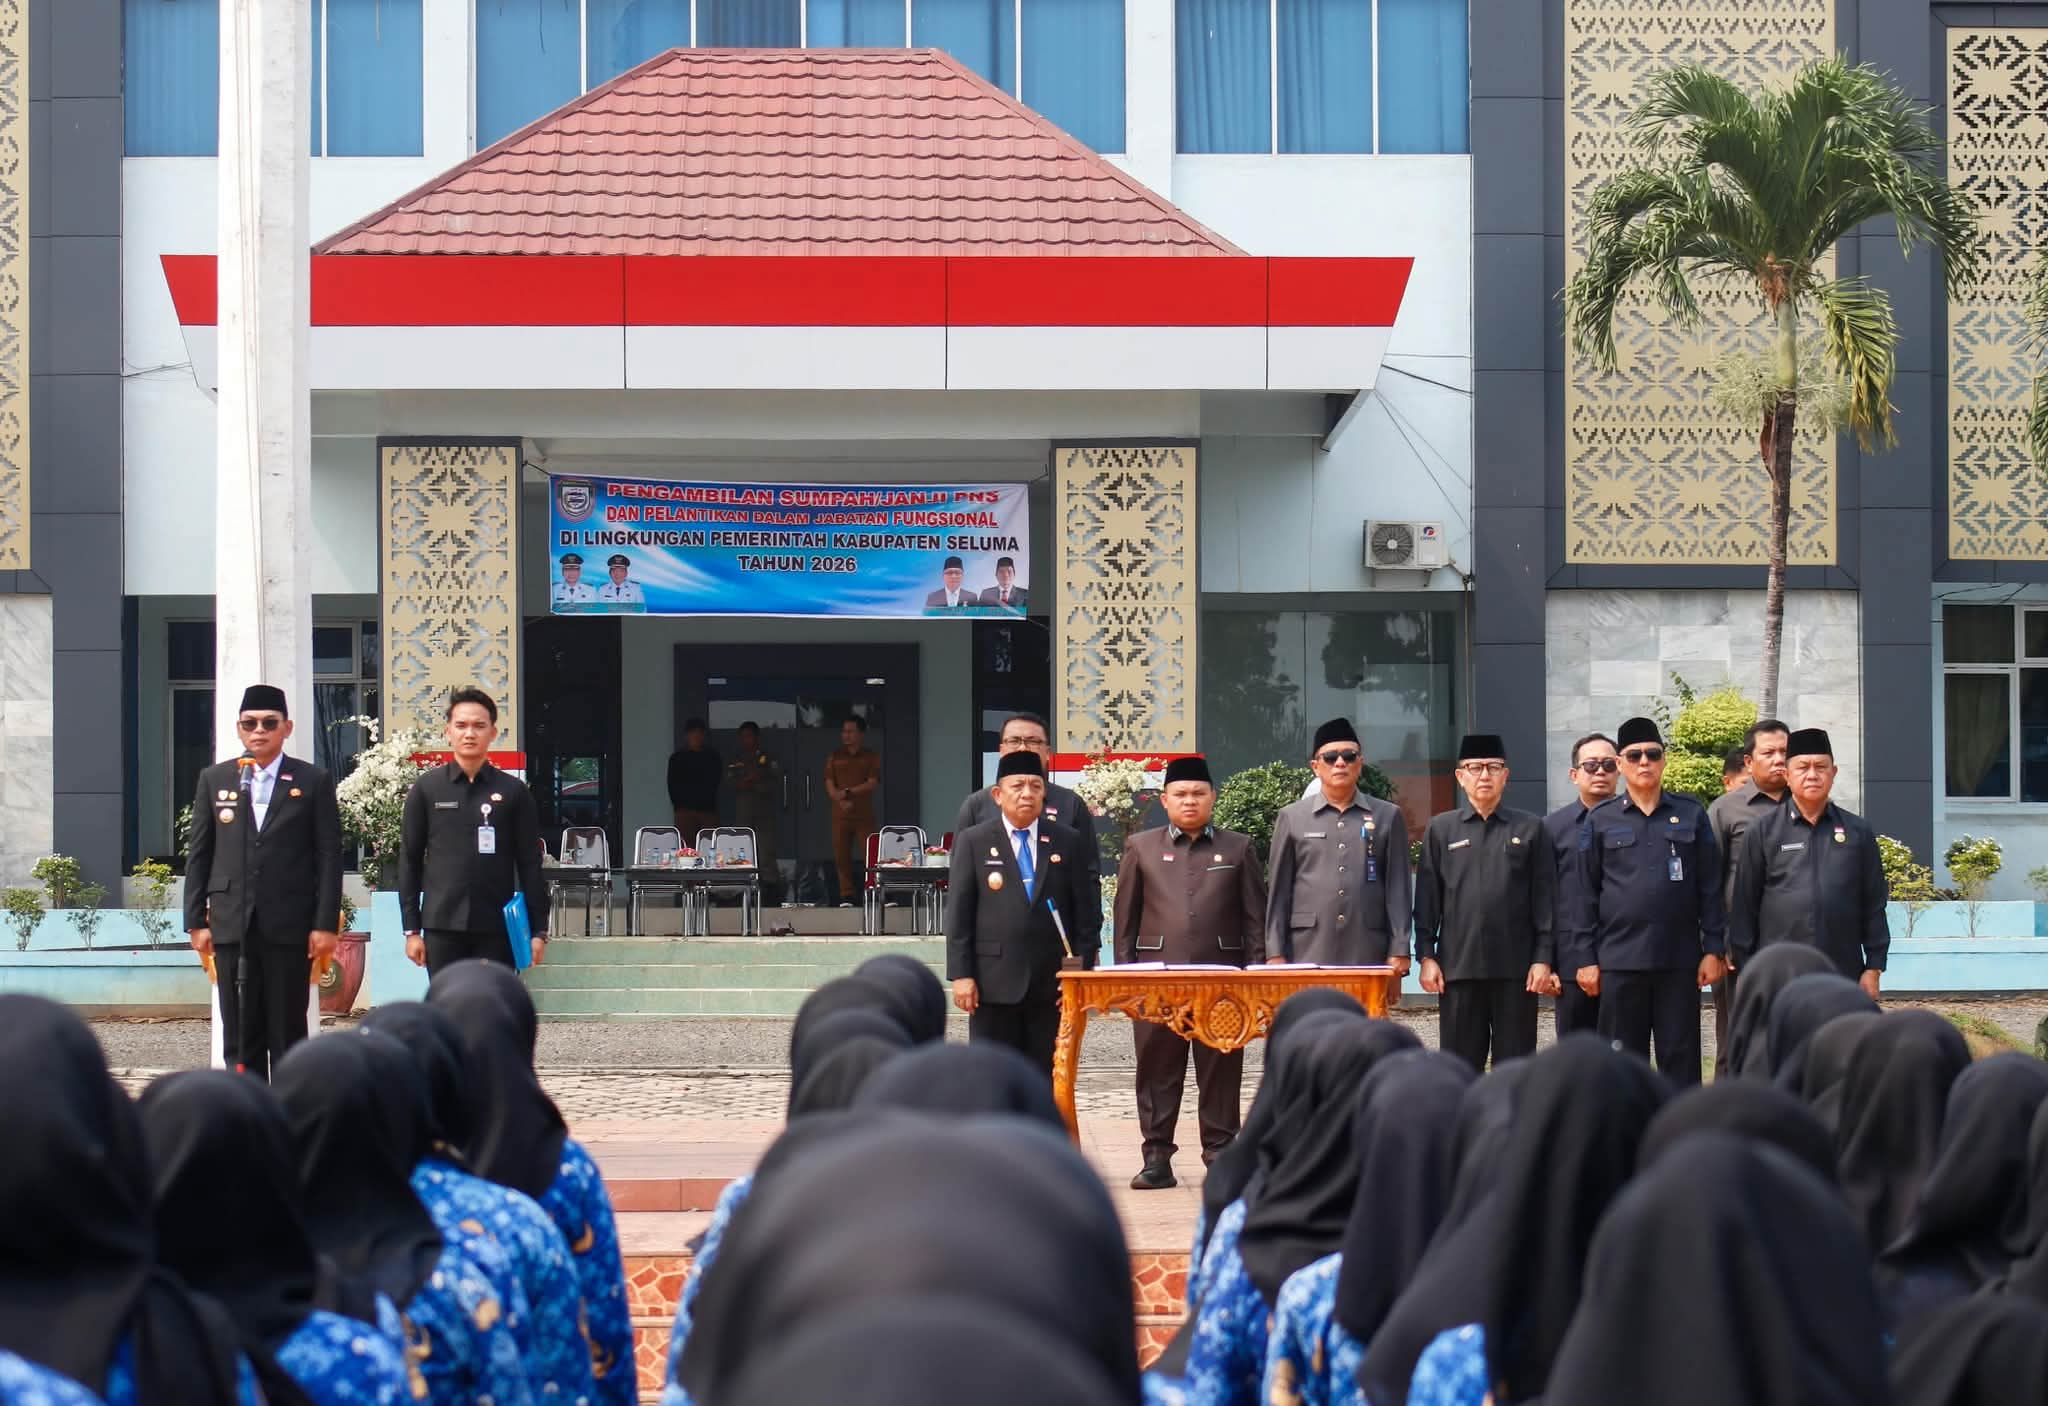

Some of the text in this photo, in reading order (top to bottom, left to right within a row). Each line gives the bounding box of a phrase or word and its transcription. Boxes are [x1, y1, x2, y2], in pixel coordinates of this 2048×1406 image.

[607, 483, 774, 506] PENGAMBILAN
[606, 506, 999, 528] DAN PELANTIKAN DALAM JABATAN FUNGSIONAL
[560, 530, 1020, 551] DI LINGKUNGAN PEMERINTAH KABUPATEN SELUMA
[738, 555, 857, 572] TAHUN 2026
